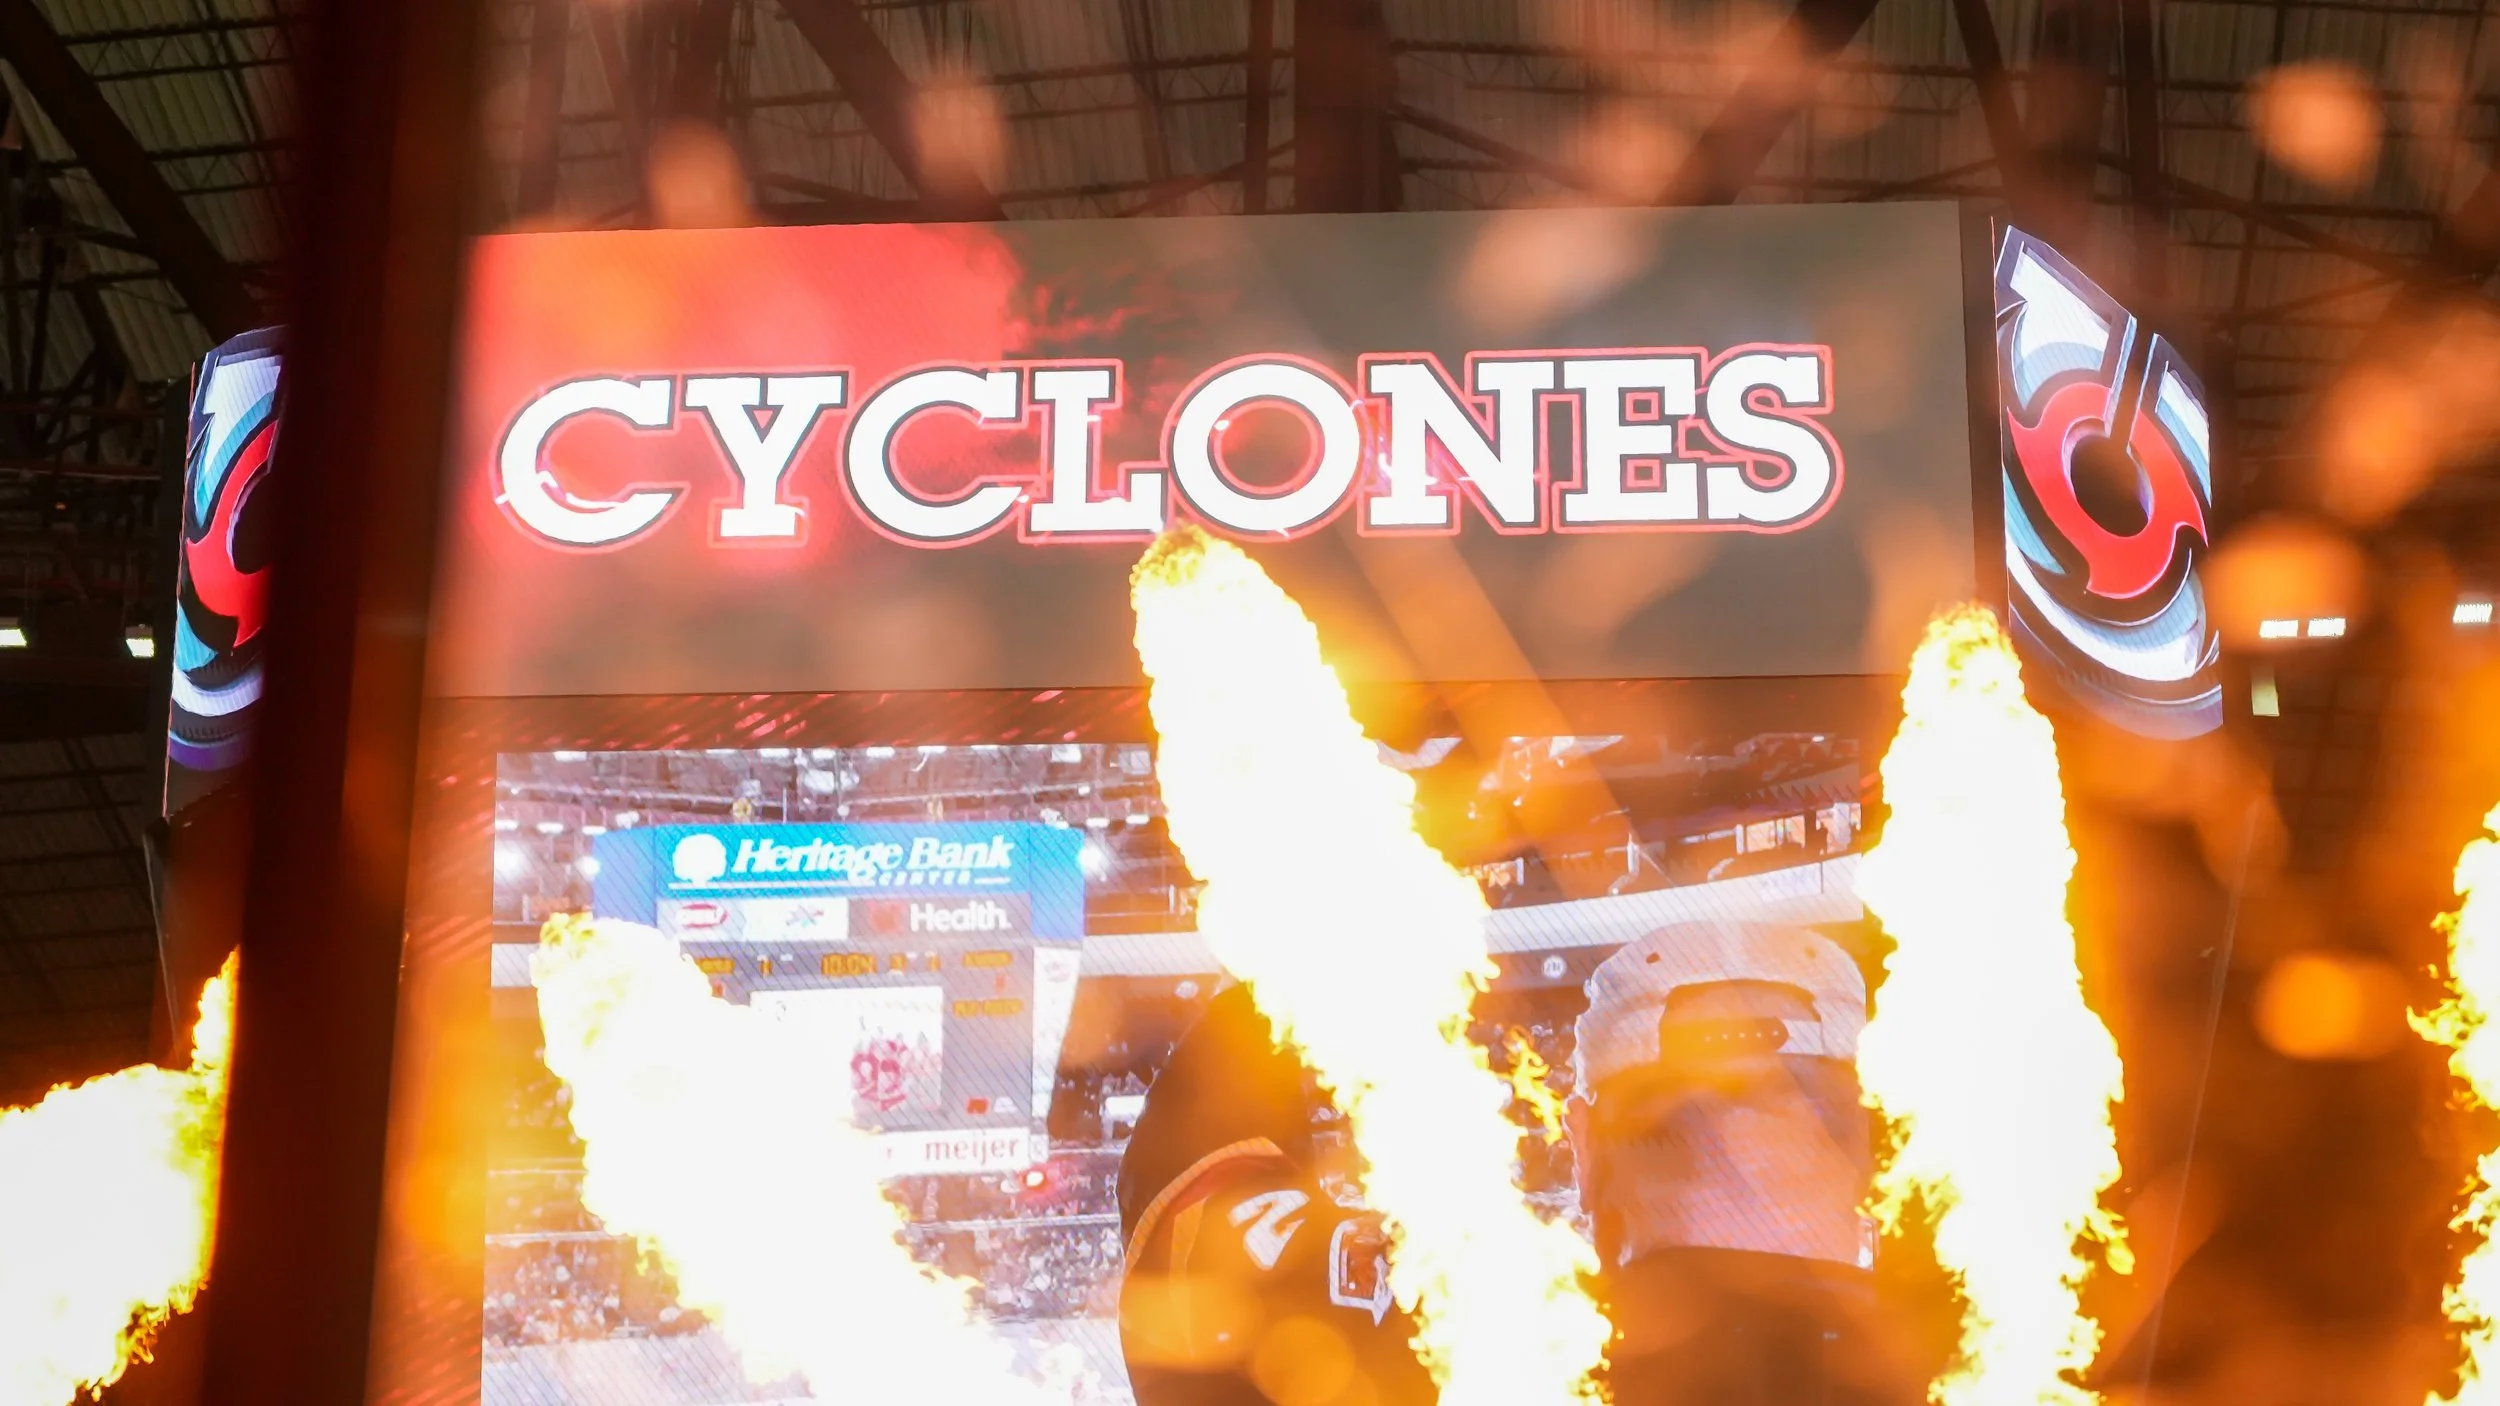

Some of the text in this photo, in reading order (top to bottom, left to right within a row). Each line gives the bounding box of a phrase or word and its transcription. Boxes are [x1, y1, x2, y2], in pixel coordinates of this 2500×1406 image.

[495, 347, 1840, 547] CYCLONES
[731, 835, 1014, 885] Heritage Bank
[925, 1131, 1019, 1165] meijer
